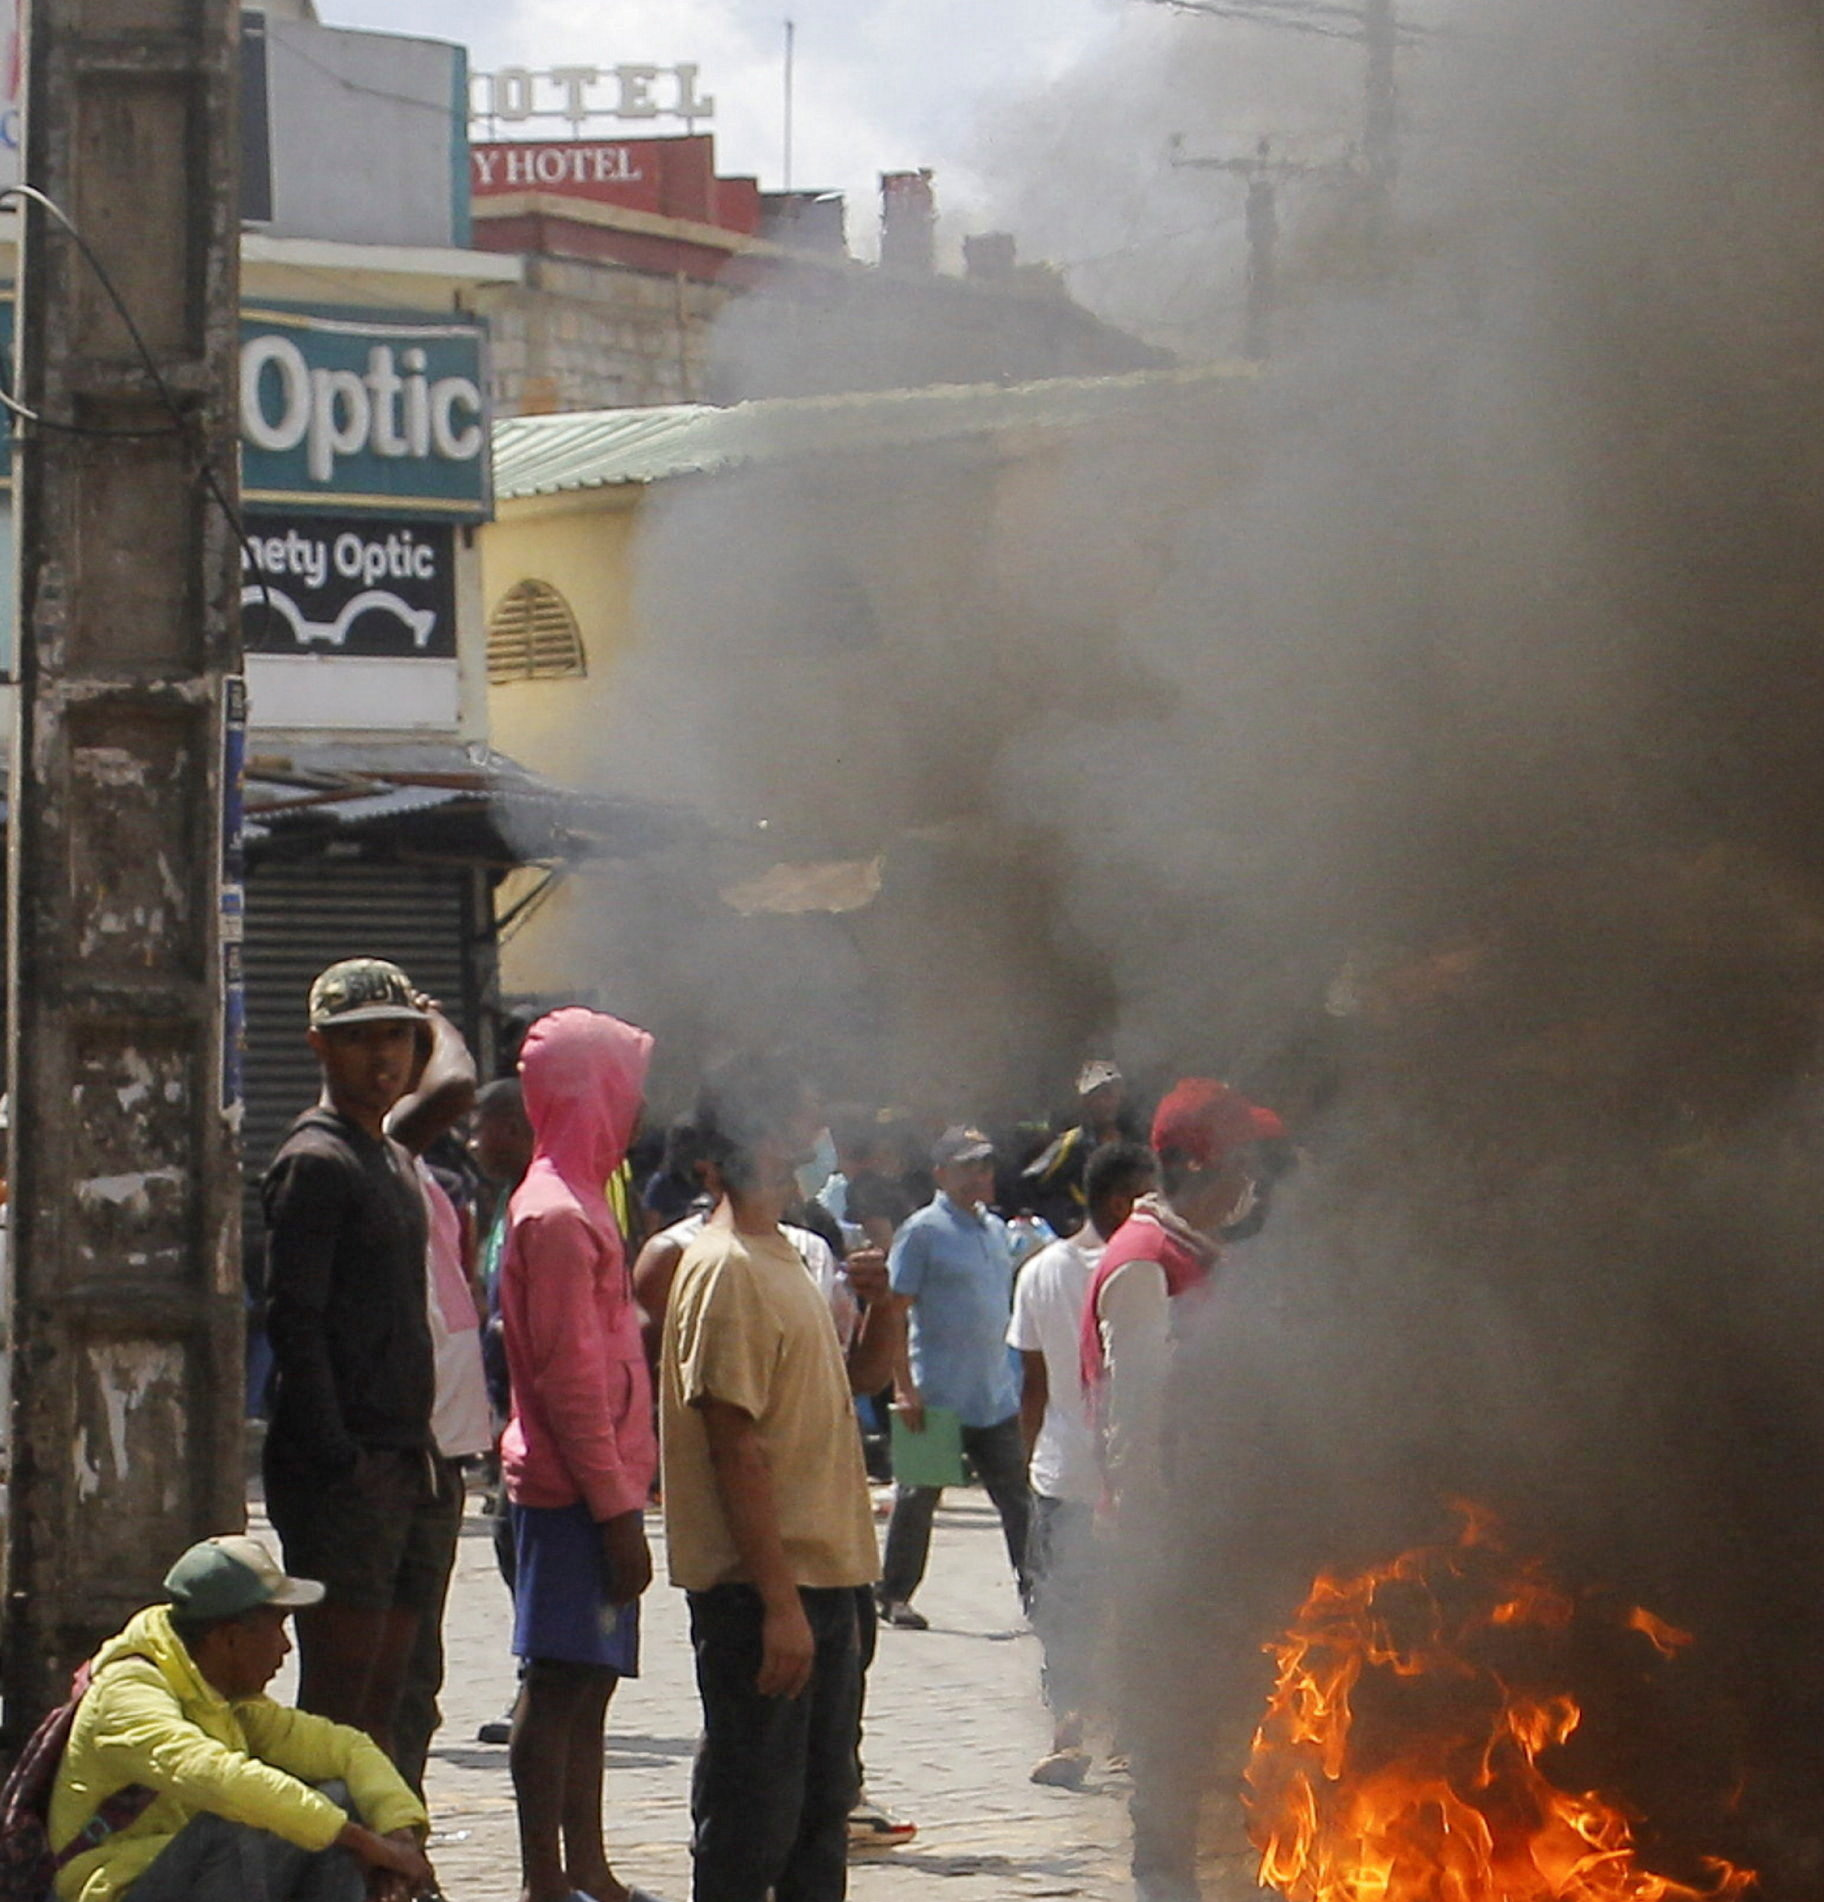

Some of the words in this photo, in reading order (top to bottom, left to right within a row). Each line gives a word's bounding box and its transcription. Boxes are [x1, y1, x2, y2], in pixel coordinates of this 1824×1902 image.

[507, 148, 642, 183] HOTEL
[240, 335, 482, 482] Optic
[334, 529, 435, 586] Optic
